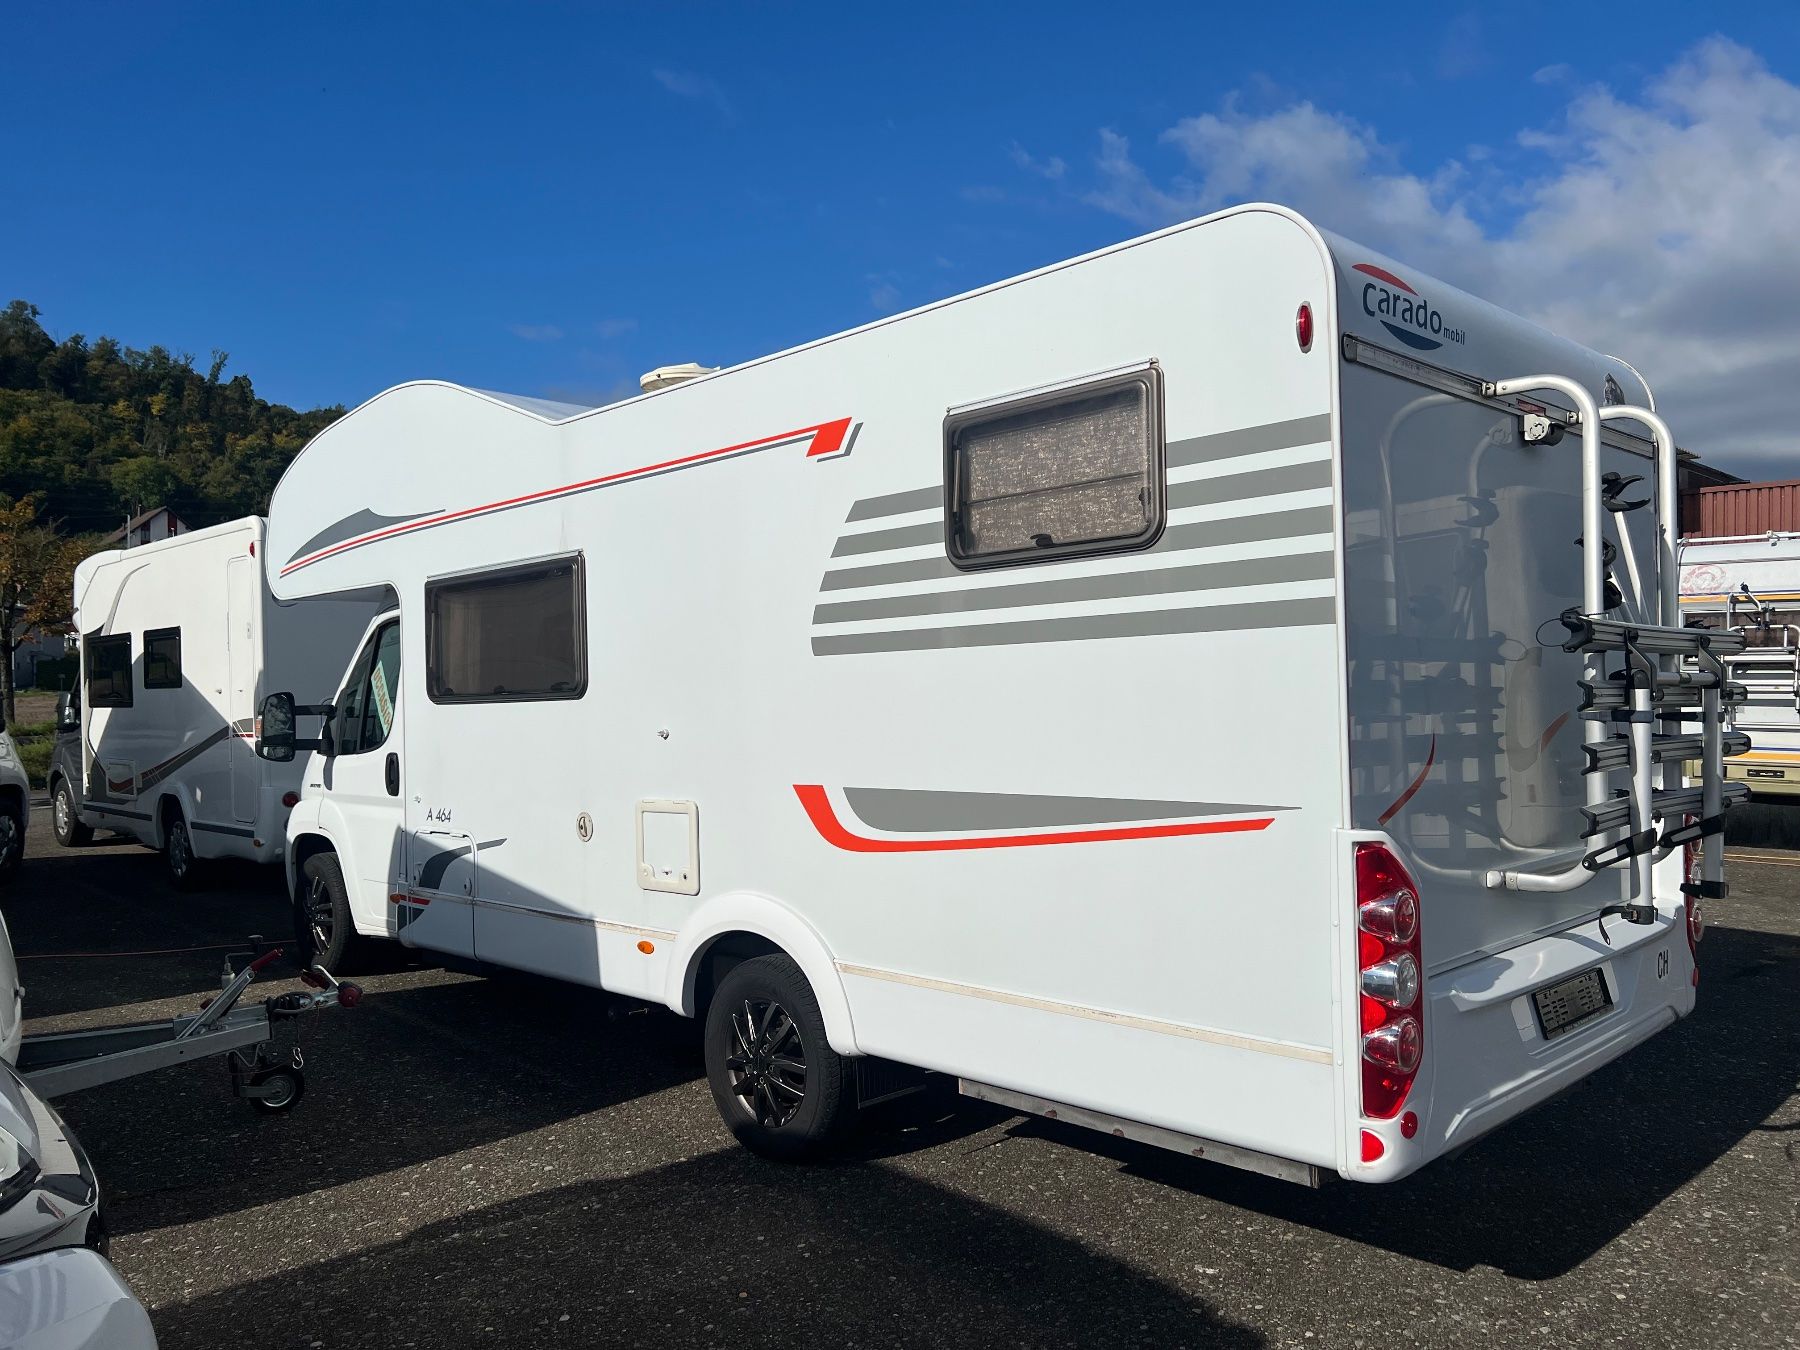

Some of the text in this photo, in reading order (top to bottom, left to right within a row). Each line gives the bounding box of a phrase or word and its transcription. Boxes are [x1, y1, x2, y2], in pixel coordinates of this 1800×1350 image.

[1444, 327, 1465, 345] mobil
[426, 808, 451, 822] A 464
[1657, 949, 1669, 979] CH
